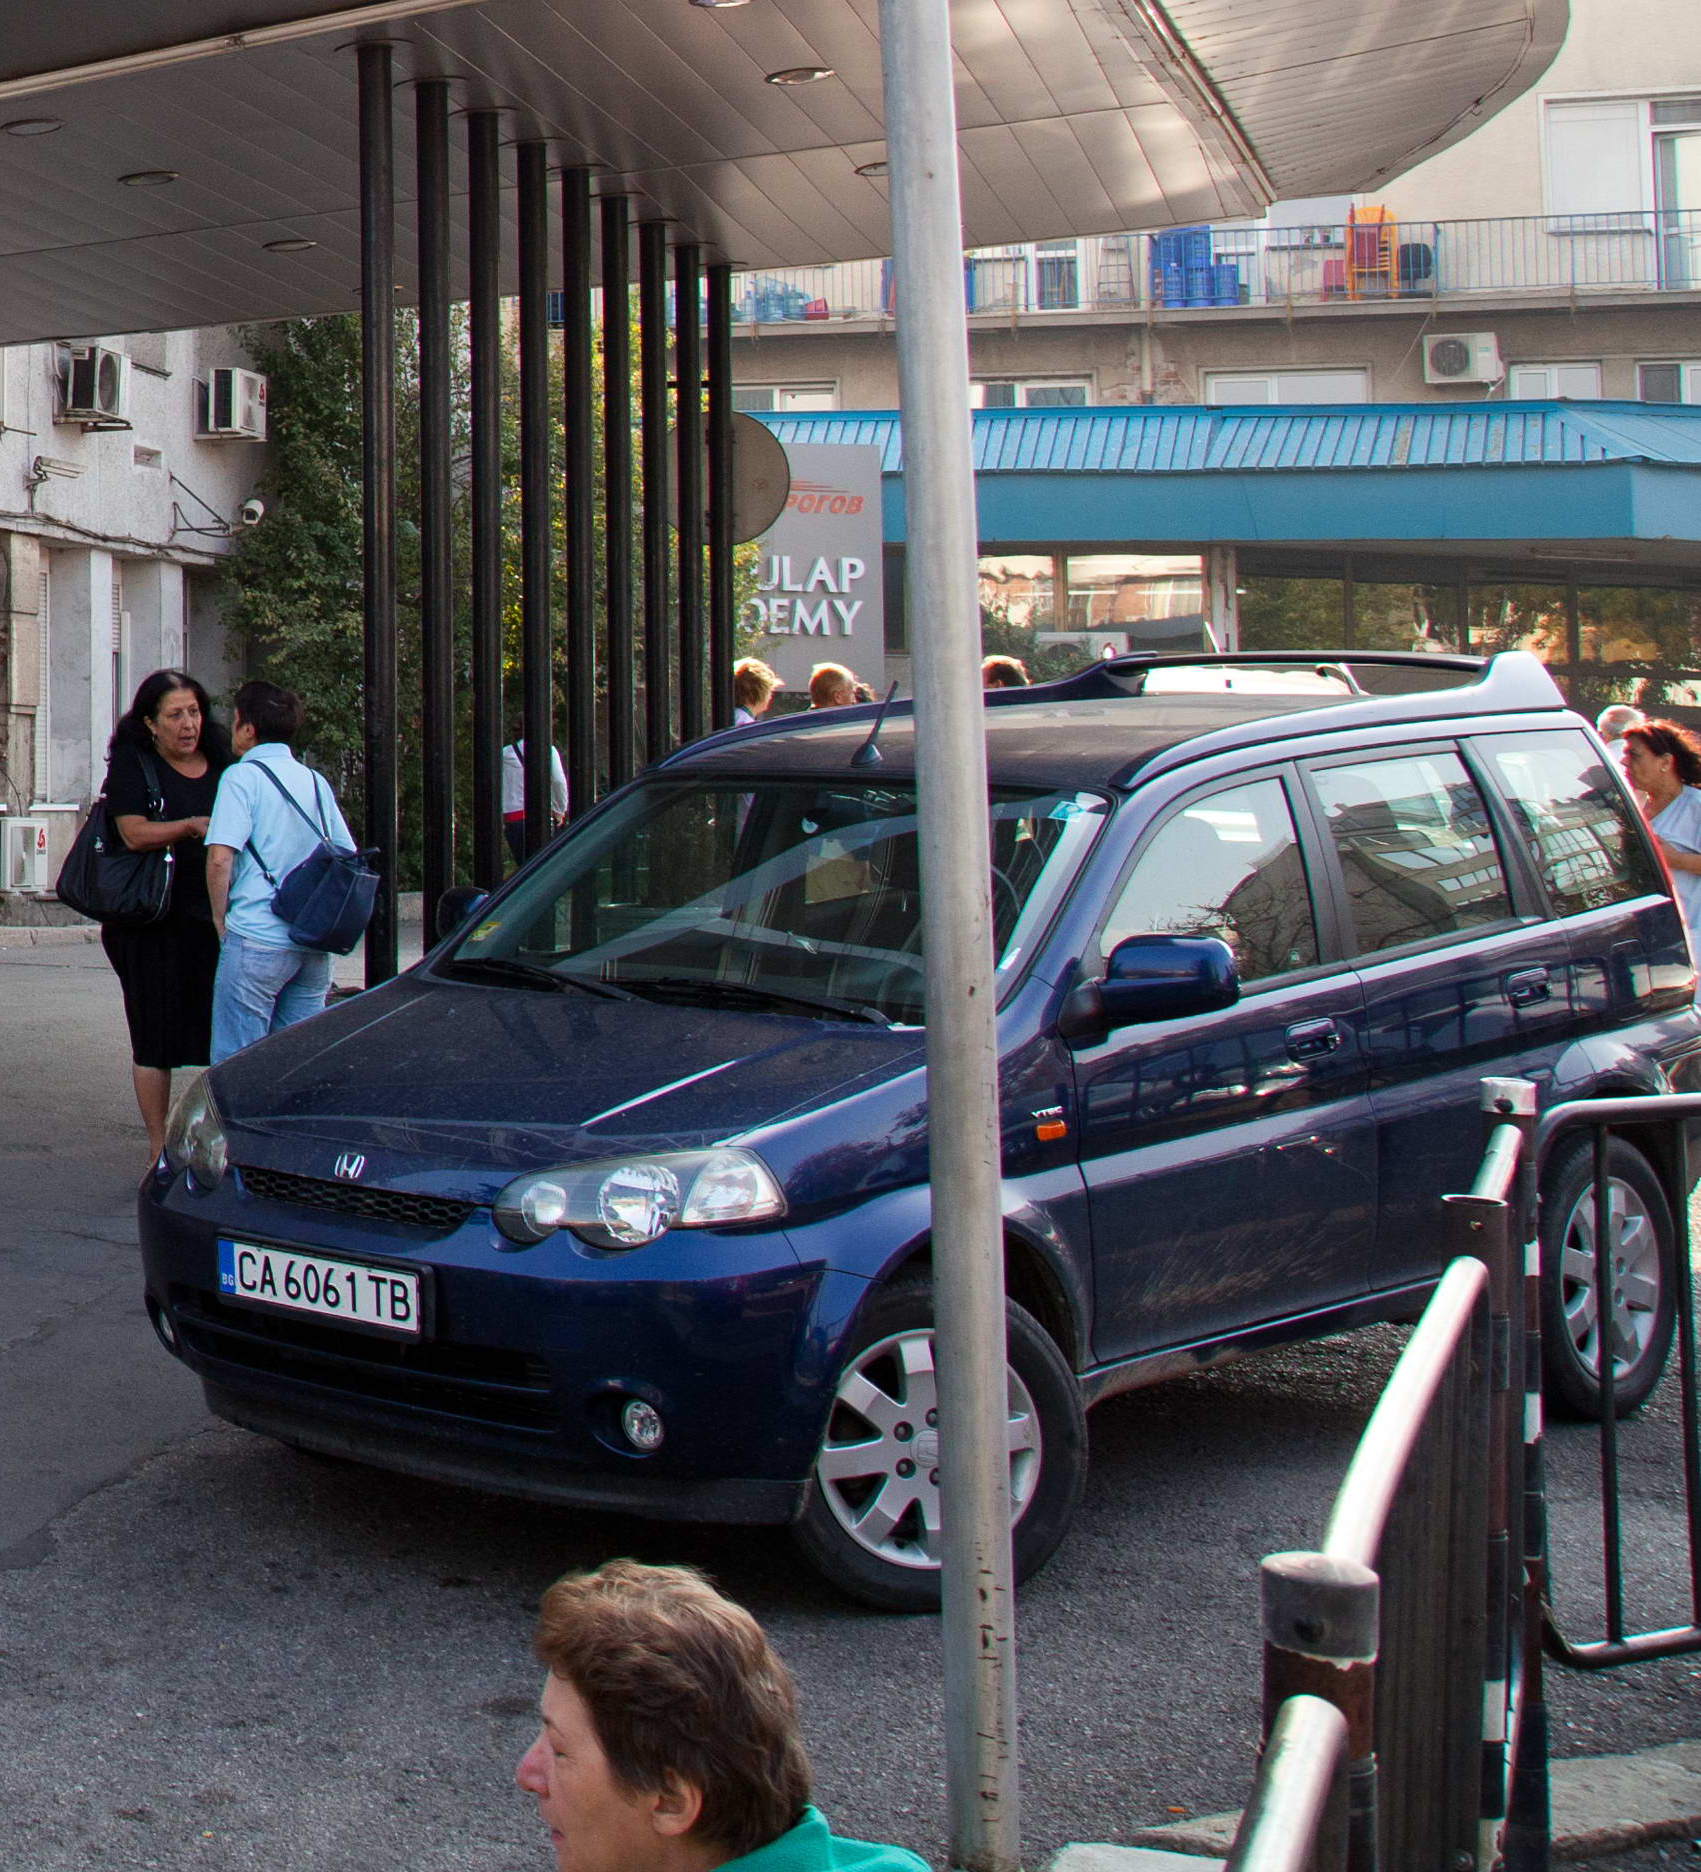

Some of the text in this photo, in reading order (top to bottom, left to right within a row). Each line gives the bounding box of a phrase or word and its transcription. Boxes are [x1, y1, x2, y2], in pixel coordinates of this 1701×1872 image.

[1031, 1106, 1063, 1118] VTEC
[222, 1272, 235, 1287] BG
[239, 1251, 410, 1321] CA 6061 TB
